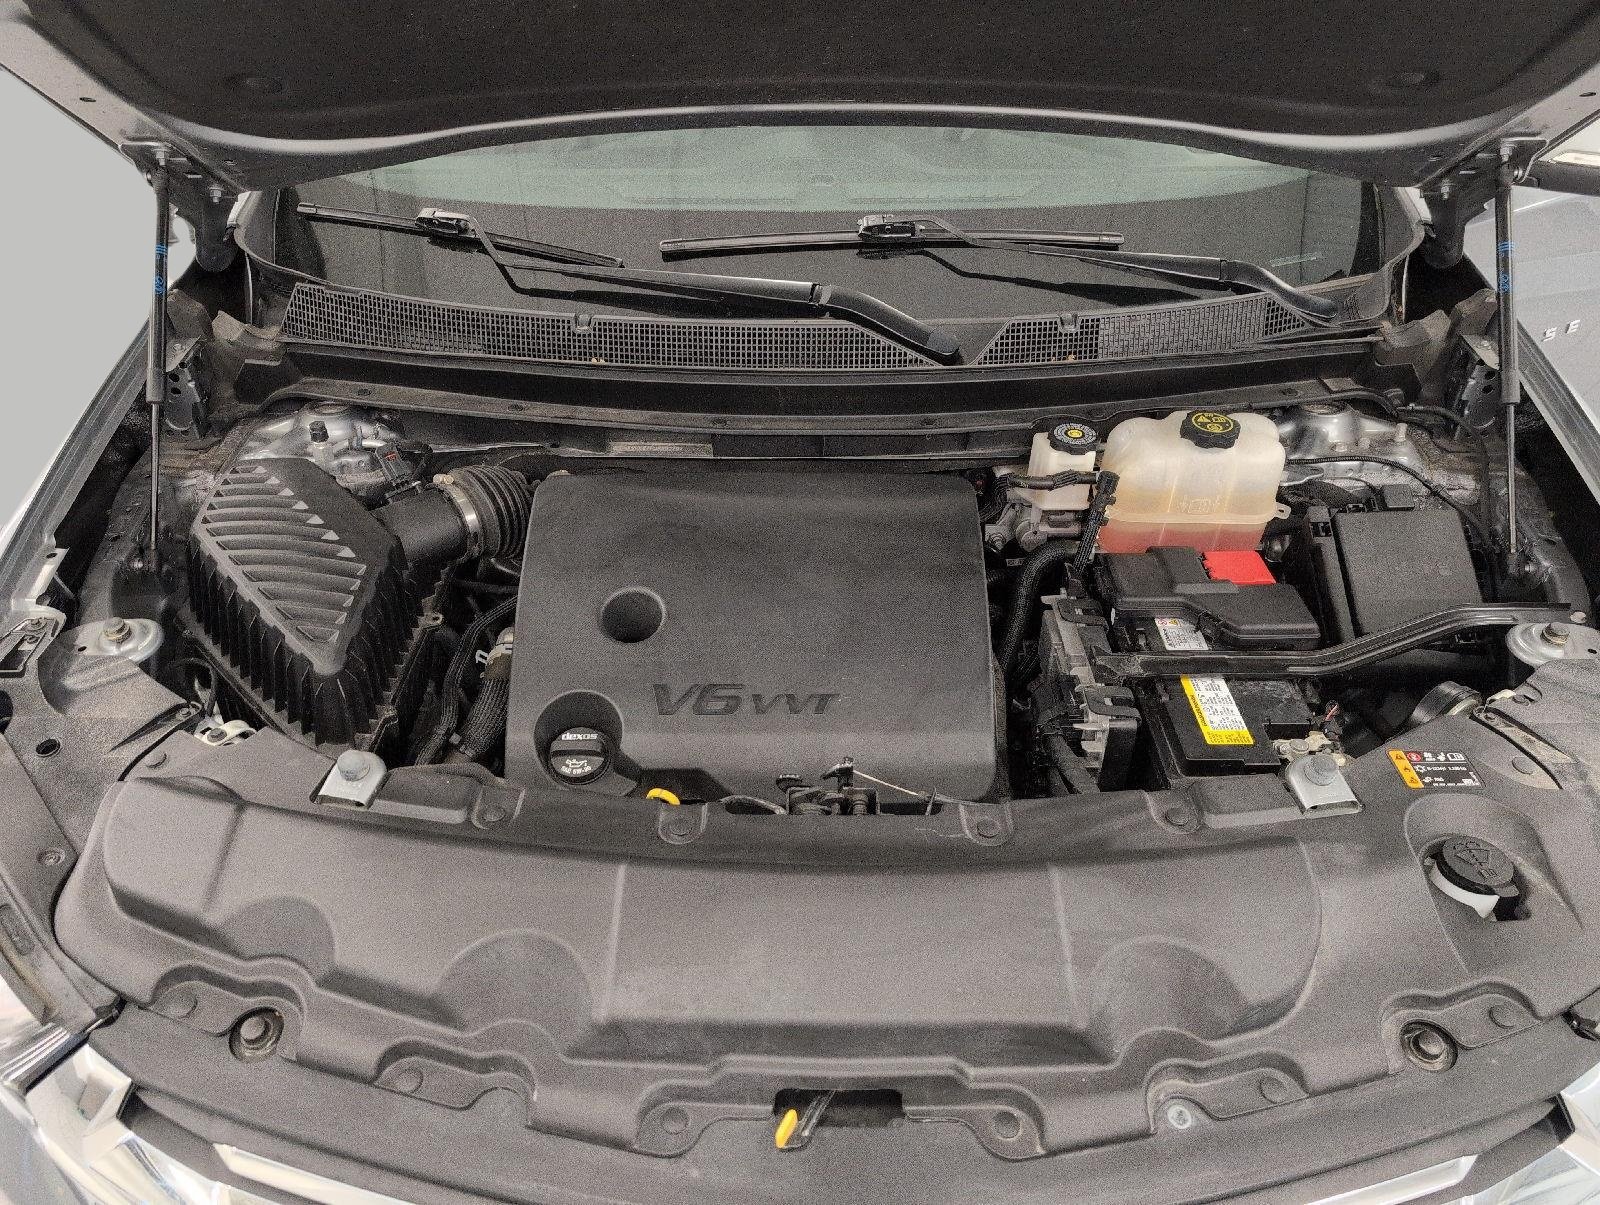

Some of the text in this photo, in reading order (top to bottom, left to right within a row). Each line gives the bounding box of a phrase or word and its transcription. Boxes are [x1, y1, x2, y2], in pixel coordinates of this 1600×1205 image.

[653, 683, 841, 716] V6 VVT
[561, 732, 599, 740] dexos
